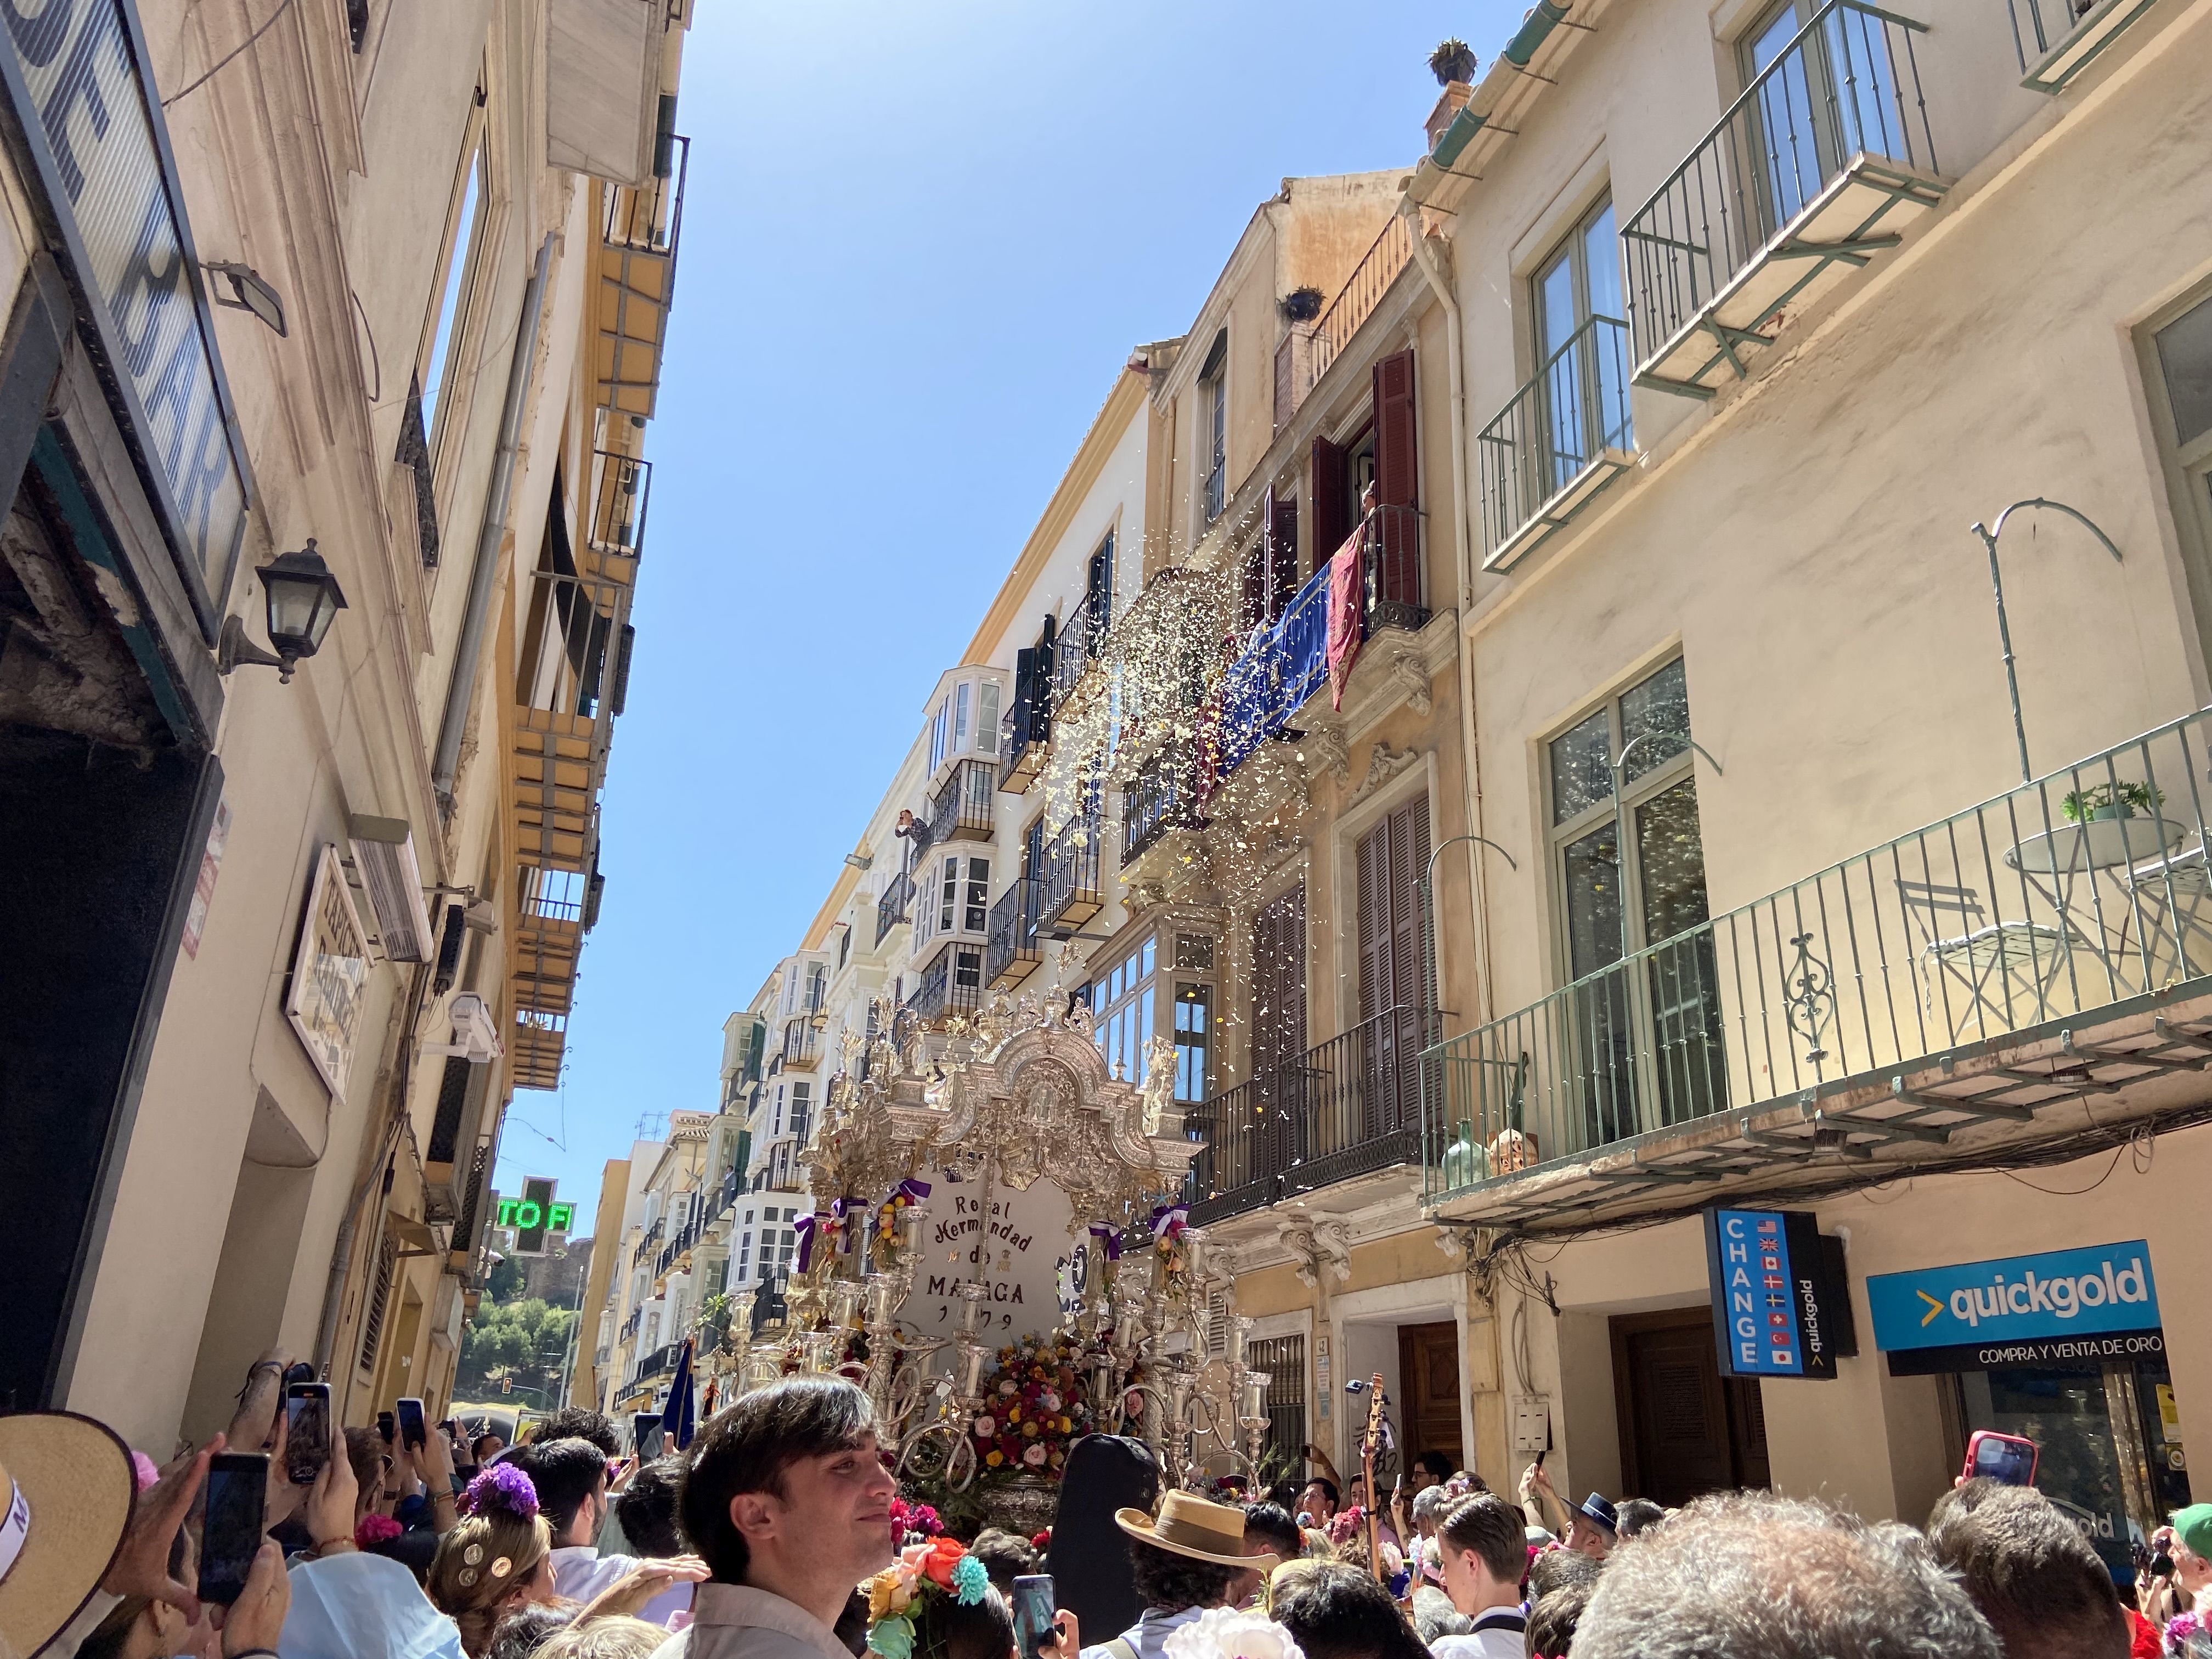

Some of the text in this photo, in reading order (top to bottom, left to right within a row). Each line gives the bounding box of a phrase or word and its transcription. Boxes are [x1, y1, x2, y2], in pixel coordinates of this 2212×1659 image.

[109, 182, 227, 576] BAR
[499, 1200, 541, 1228] TO
[955, 1196, 1011, 1219] Real
[935, 1219, 1032, 1252] Hermndad
[927, 1275, 1024, 1304] MAAGA
[1726, 1218, 1757, 1364] CHANGE
[1950, 1257, 2148, 1327] quickgold
[938, 1305, 1012, 1330] 179
[1799, 1279, 1822, 1353] quickgold
[1318, 1340, 1325, 1353] 42
[1979, 1335, 2163, 1364] COMPRA Y VENTA DE ORO
